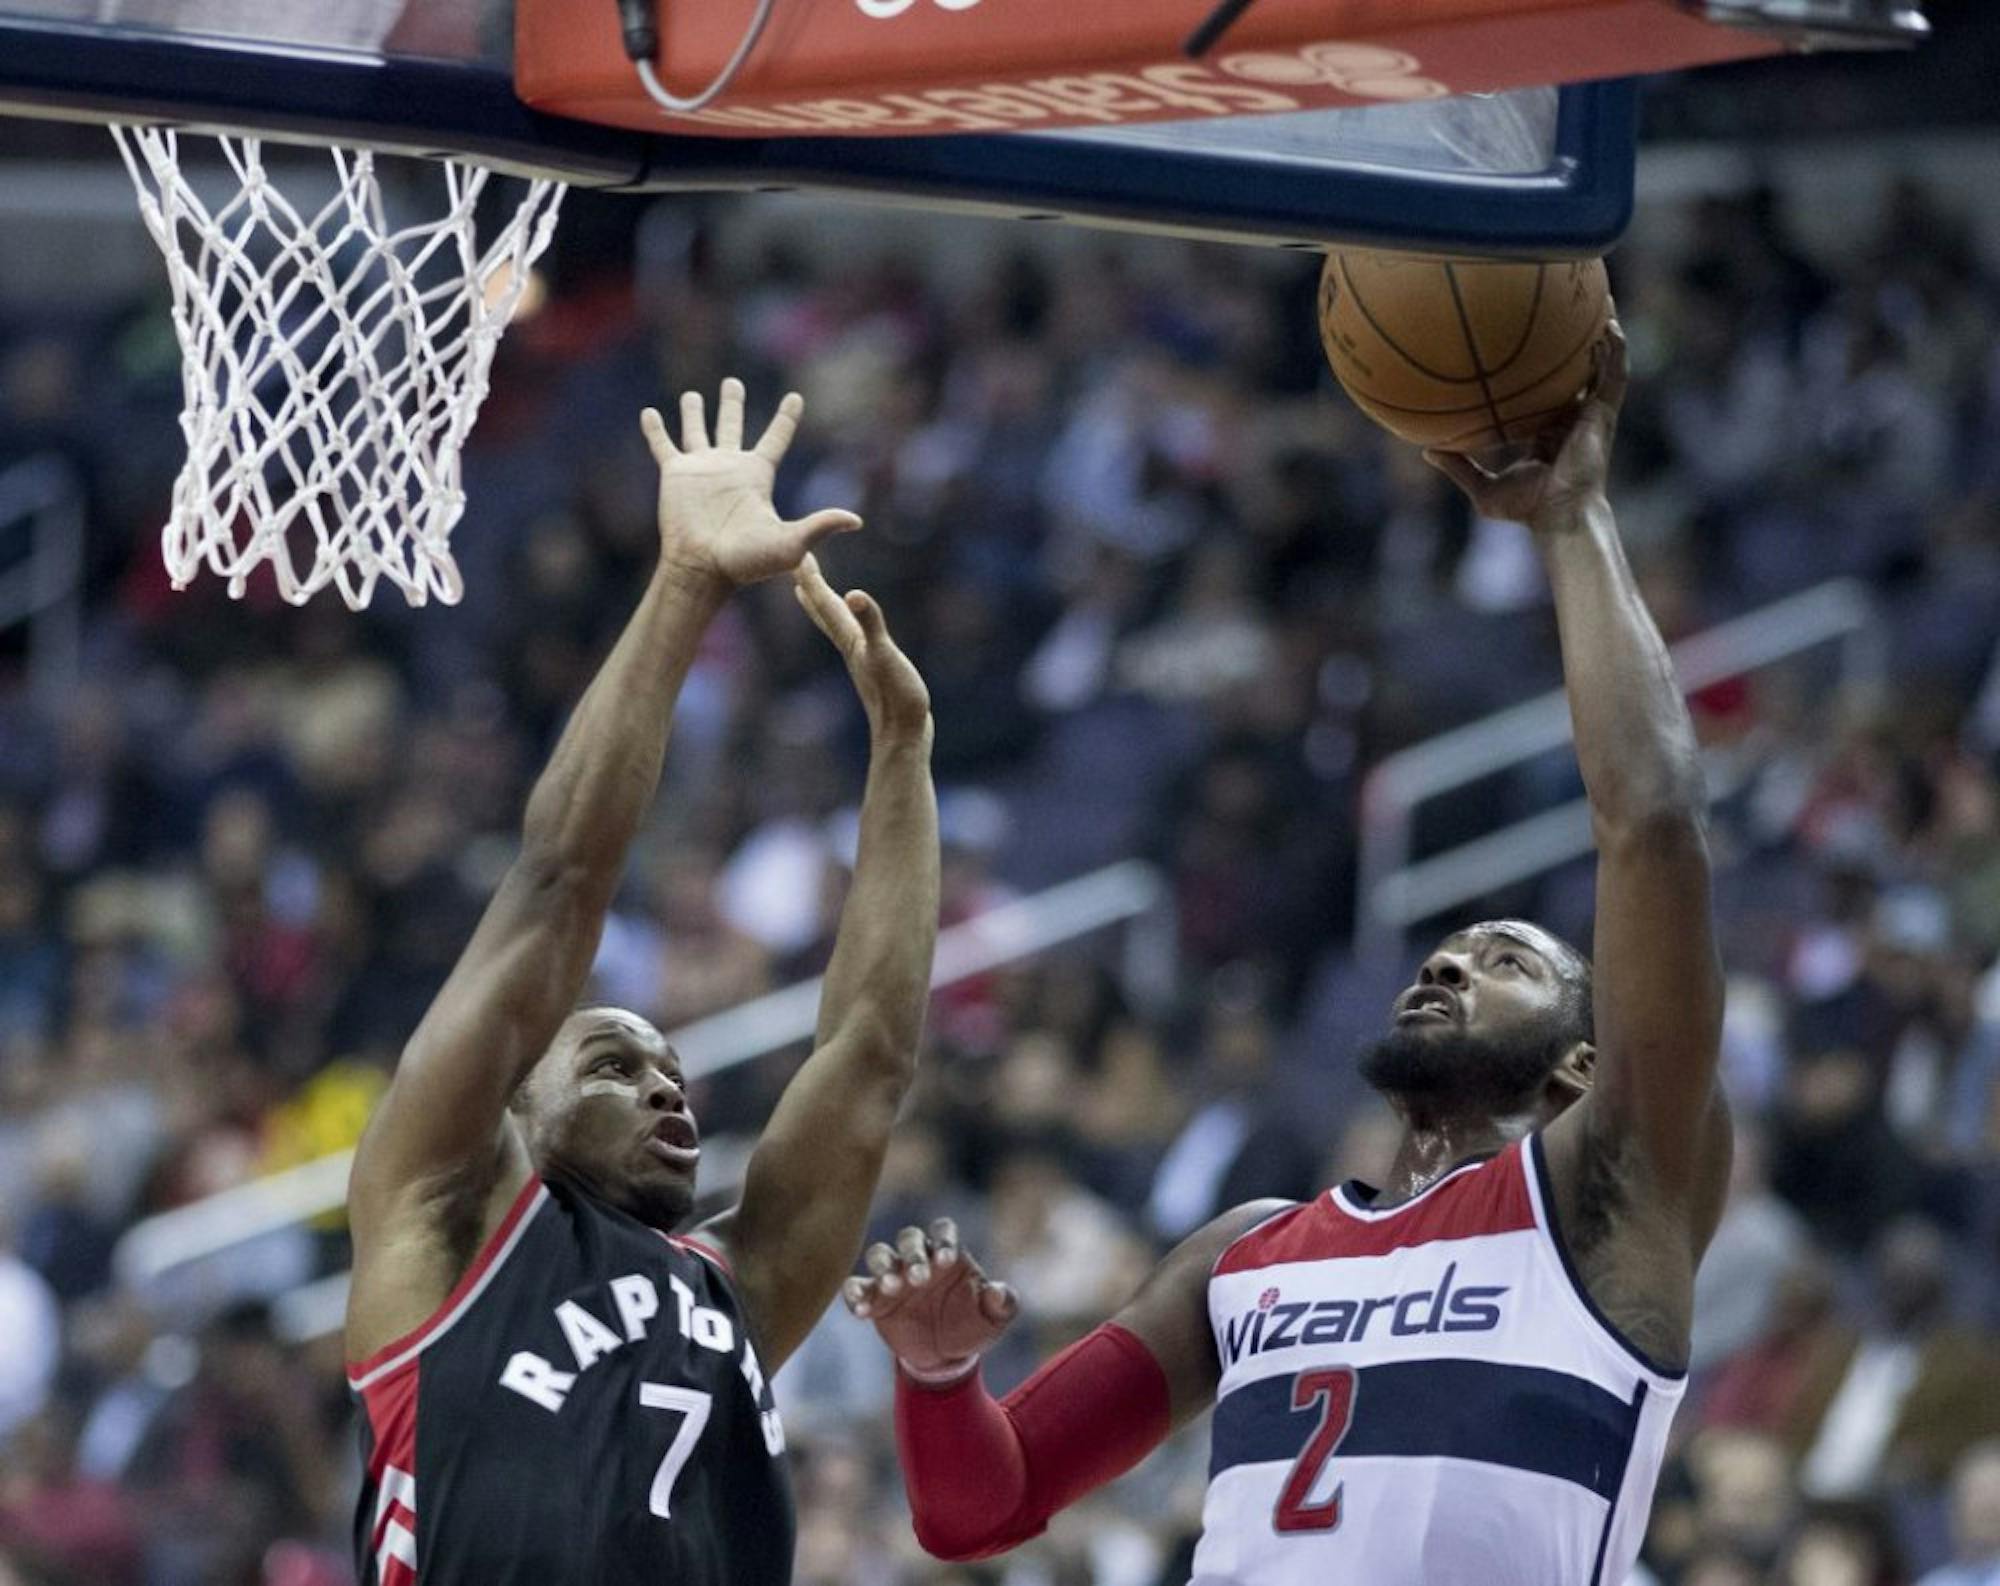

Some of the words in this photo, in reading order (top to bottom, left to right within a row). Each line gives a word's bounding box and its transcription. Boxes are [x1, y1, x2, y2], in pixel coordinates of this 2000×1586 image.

[1220, 1260, 1511, 1369] wizards
[639, 1382, 713, 1520] 7
[1271, 1363, 1359, 1537] 2
